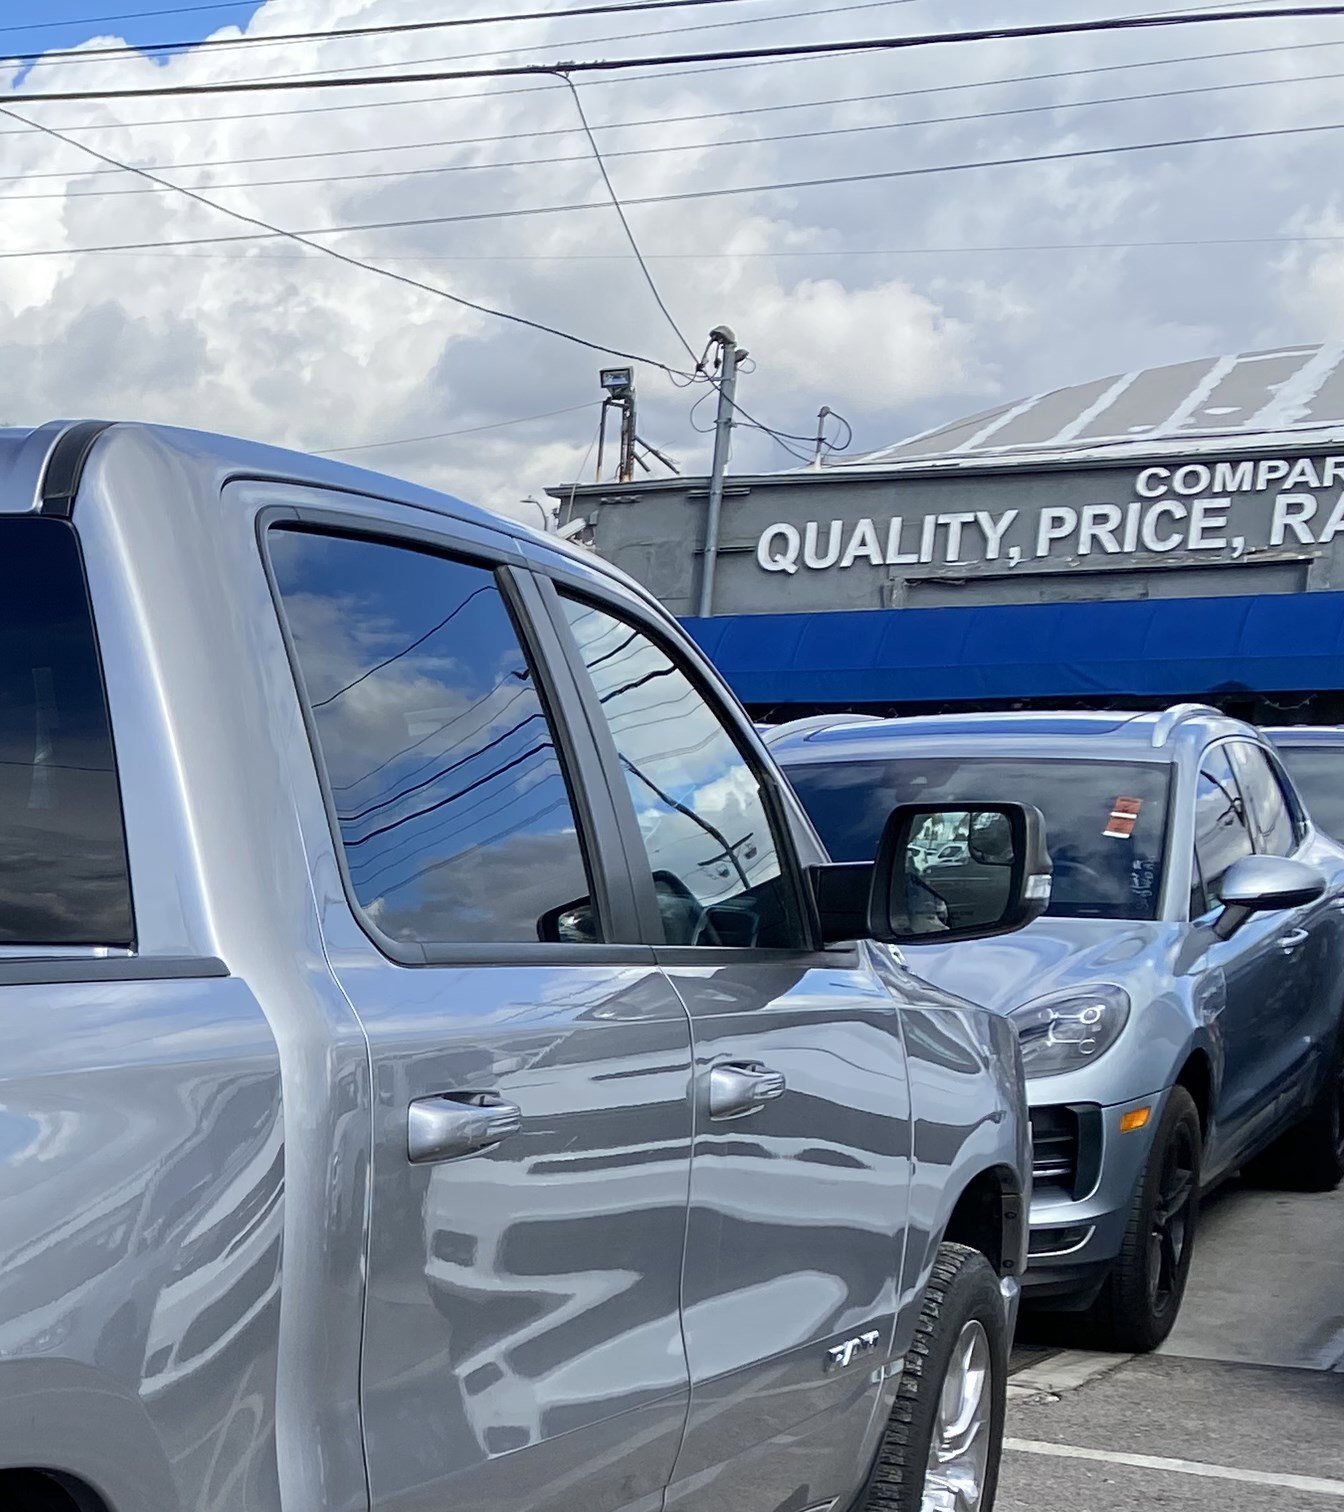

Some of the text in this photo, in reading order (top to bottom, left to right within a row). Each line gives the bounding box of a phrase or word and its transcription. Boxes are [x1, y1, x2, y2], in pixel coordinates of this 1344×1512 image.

[1136, 456, 1344, 498] COMPAR
[757, 509, 1022, 576] QUALITY,
[1036, 497, 1246, 558] PRICE,
